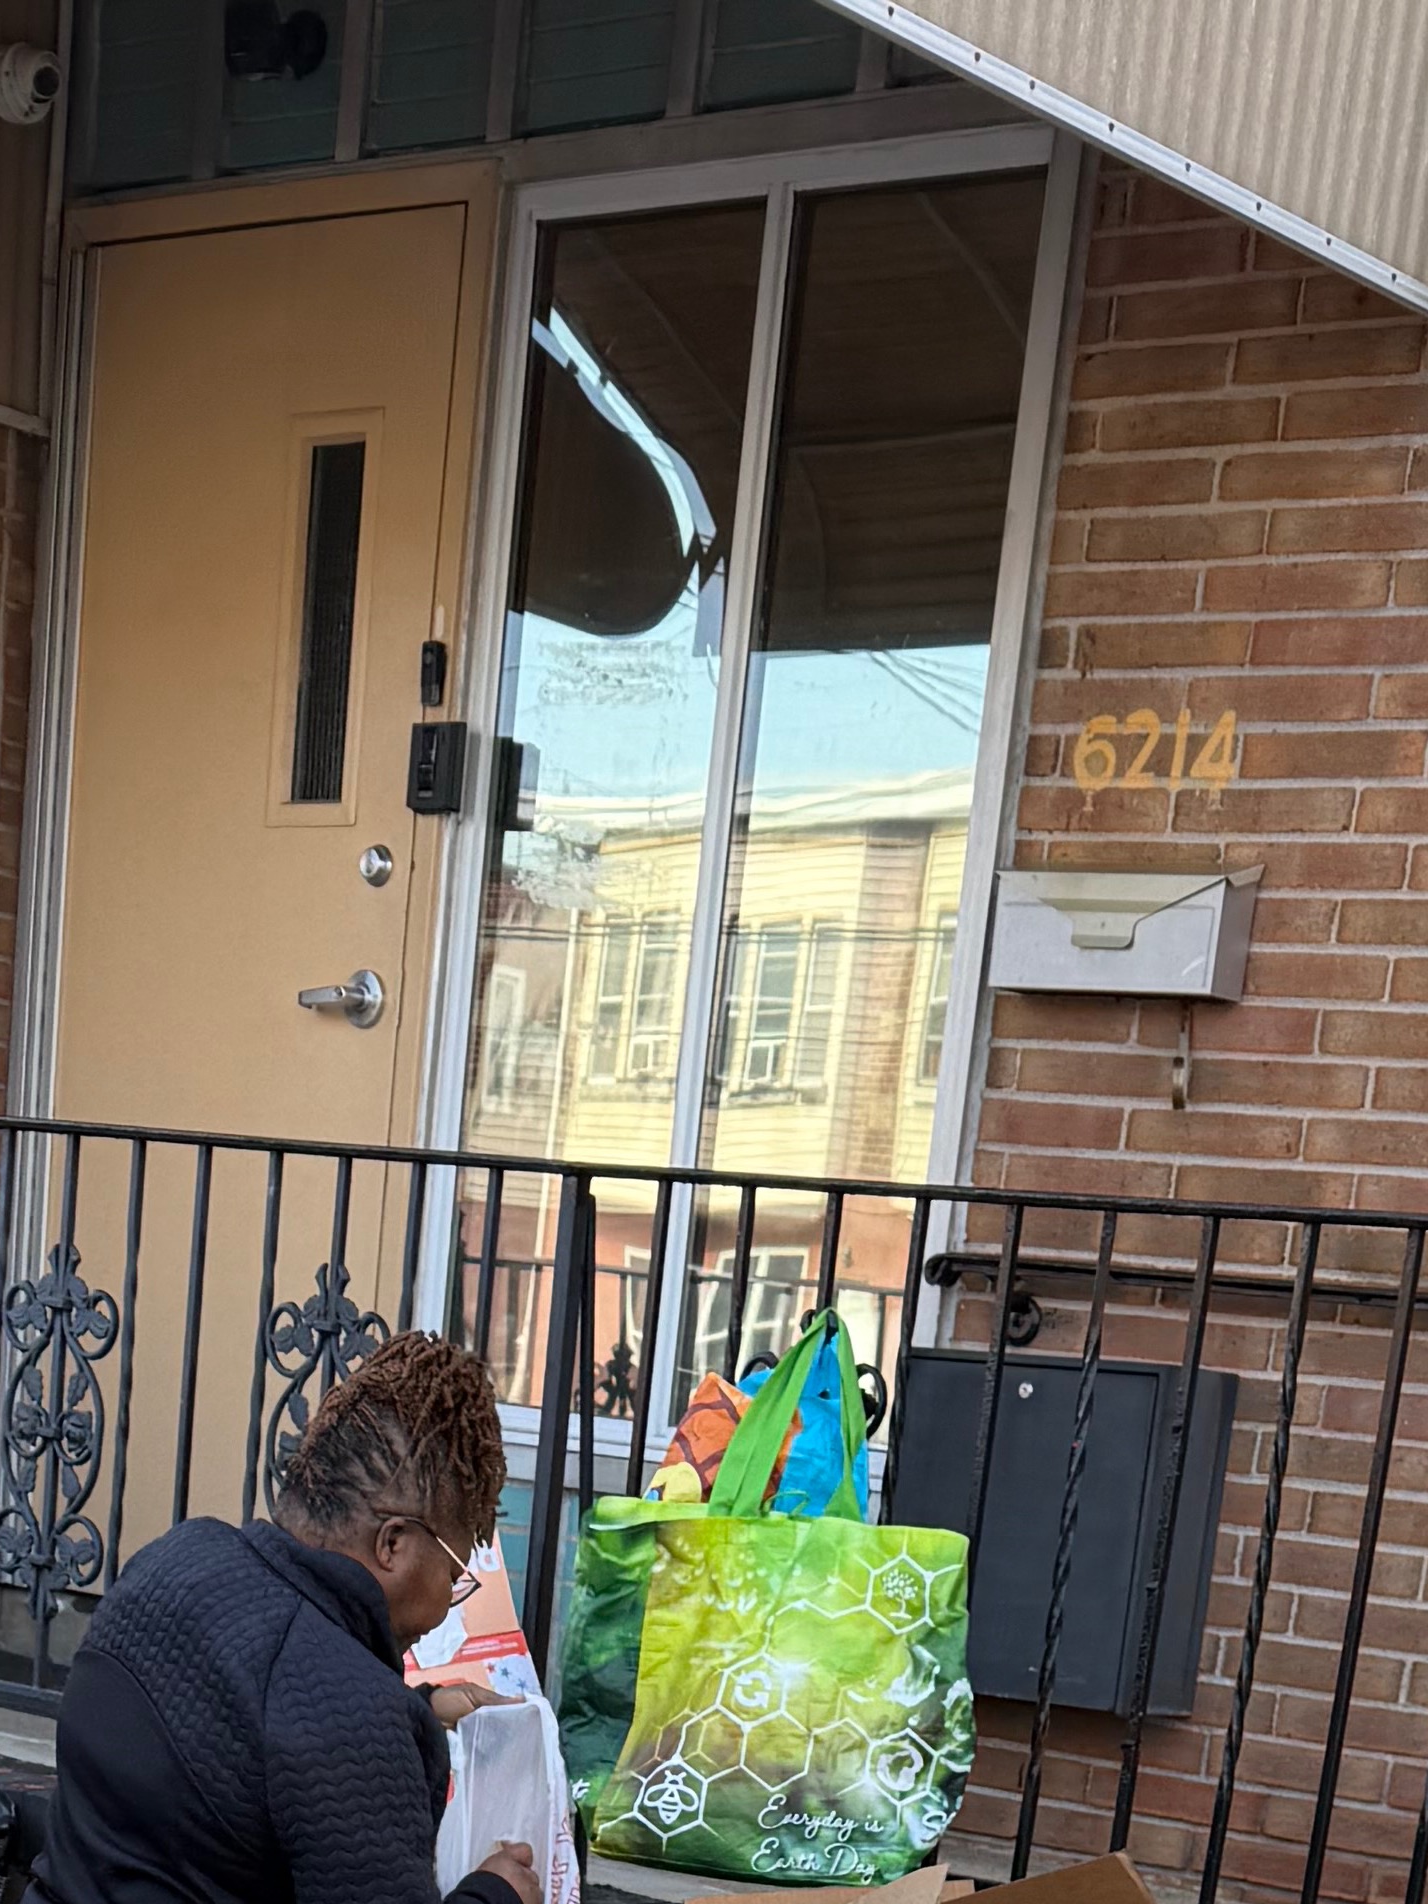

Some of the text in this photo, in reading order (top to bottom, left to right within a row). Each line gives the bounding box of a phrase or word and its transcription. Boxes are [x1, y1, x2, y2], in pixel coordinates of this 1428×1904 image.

[1073, 708, 1237, 792] 6214
[757, 1793, 859, 1841] Everyday
[864, 1814, 884, 1833] is
[750, 1836, 879, 1886] Earth Day
